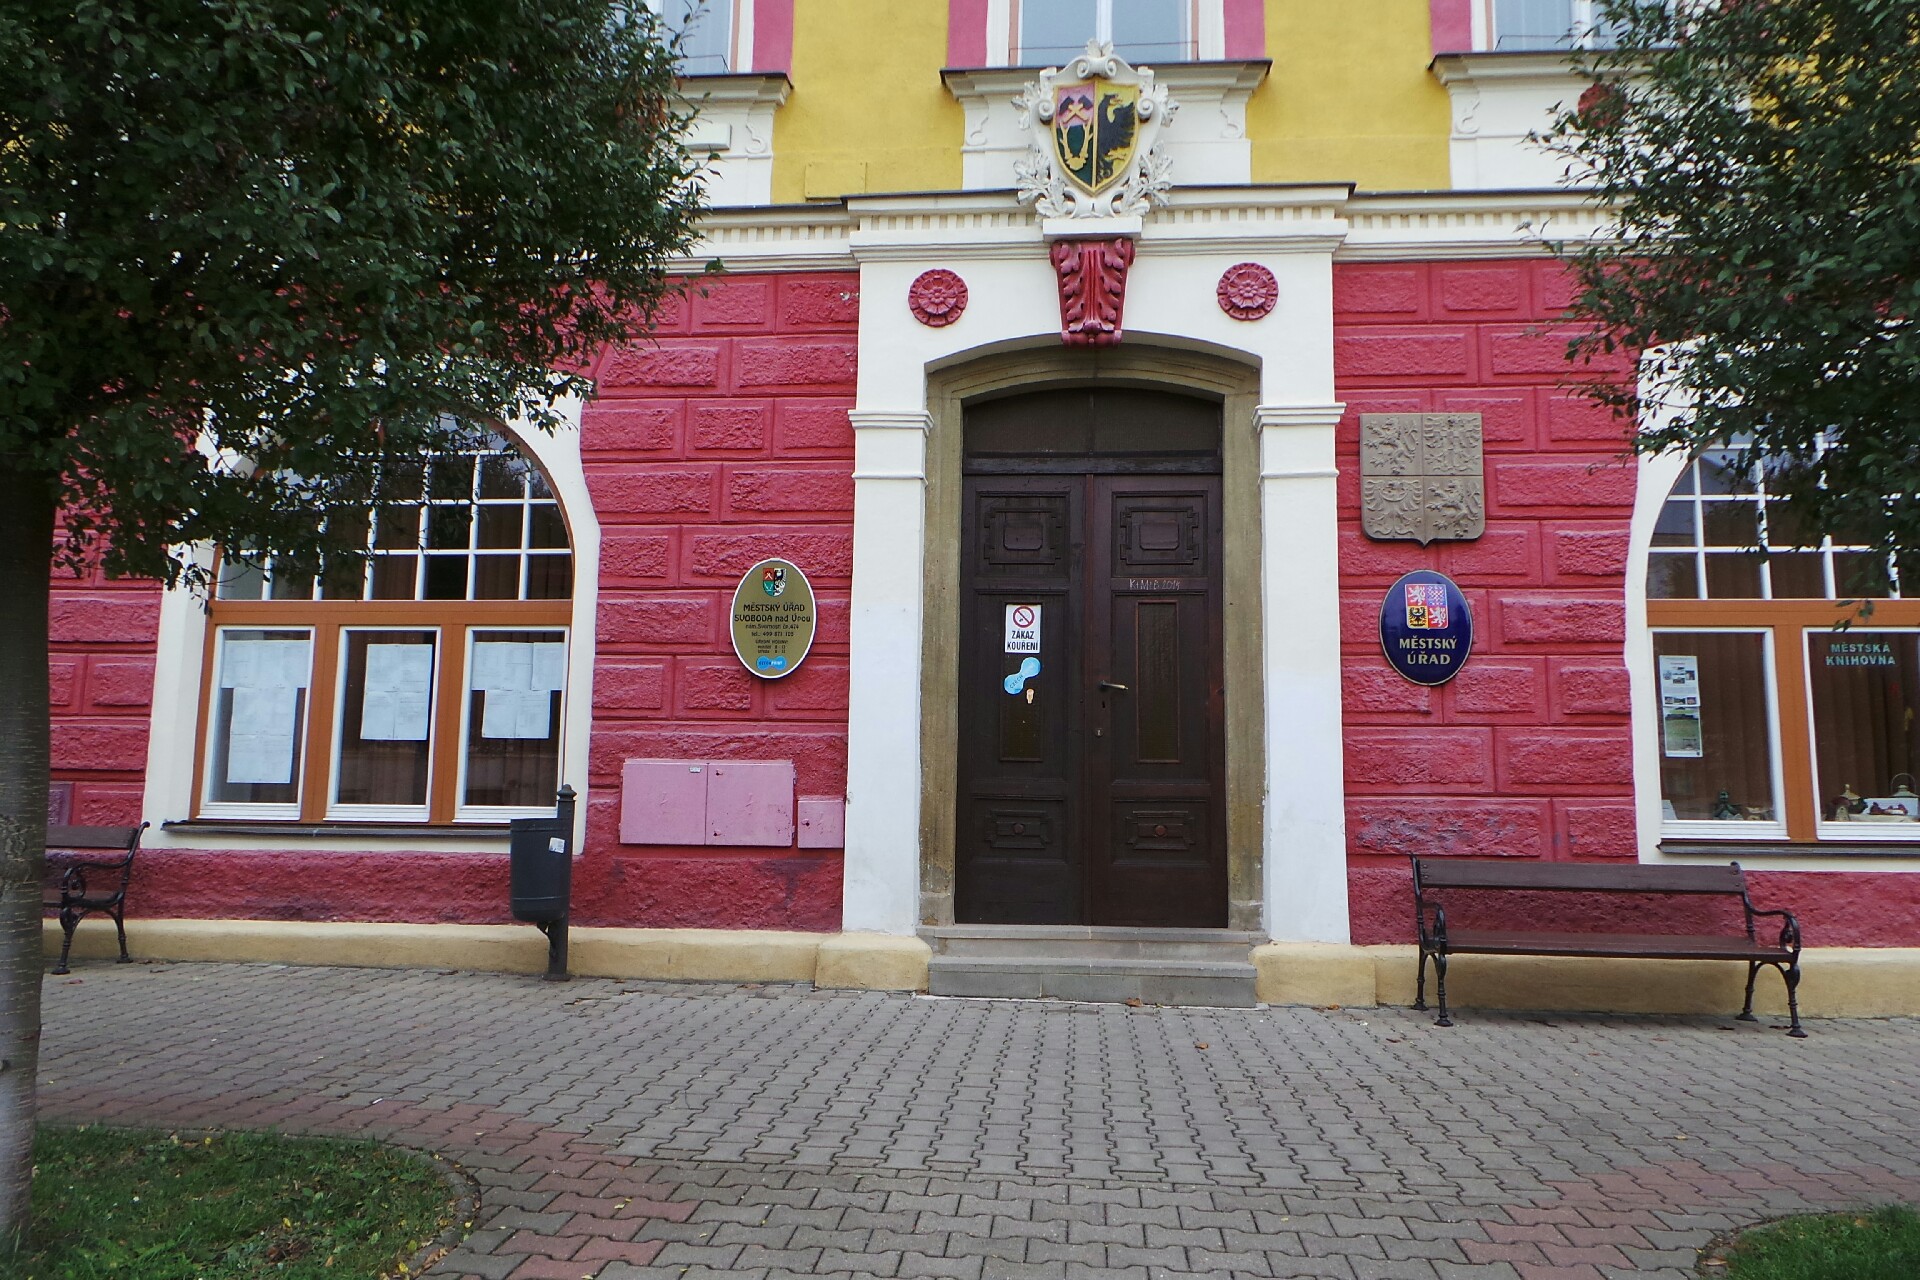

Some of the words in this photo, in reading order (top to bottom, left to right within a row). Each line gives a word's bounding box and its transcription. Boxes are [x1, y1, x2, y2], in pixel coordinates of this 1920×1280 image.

[743, 602, 781, 612] MĚSTSKÝ
[783, 601, 805, 612] ÚŘAD
[734, 614, 773, 622] SVOBODA
[775, 614, 789, 622] nad
[791, 613, 811, 623] Úpou
[1011, 629, 1035, 640] ZÁKAZ
[1006, 639, 1038, 651] KOUŘENÍ
[1399, 635, 1457, 649] MĚSTSKÝ
[1830, 641, 1891, 653] MĚSTSKÁ
[1407, 651, 1451, 665] ÚŘAD
[1825, 655, 1896, 666] KNIHOVNA
